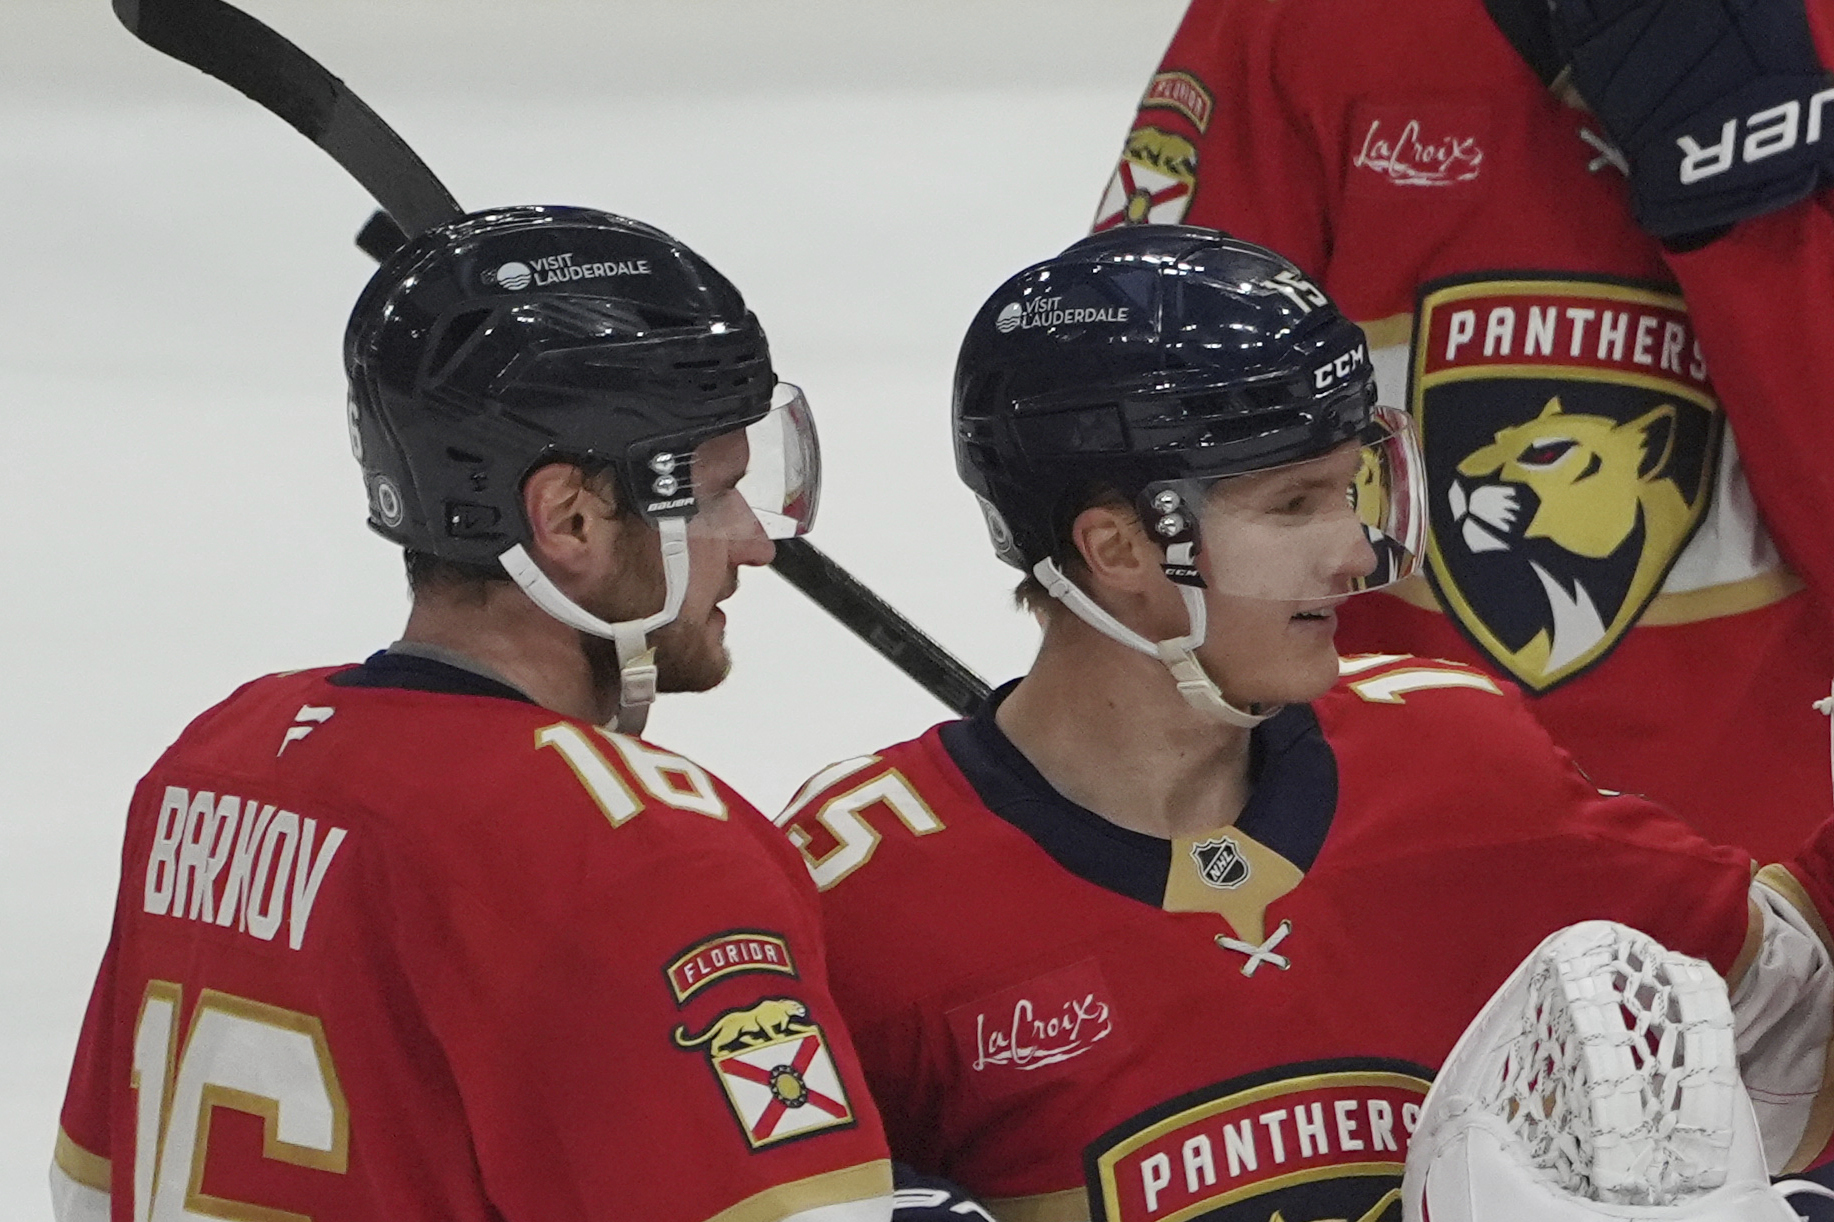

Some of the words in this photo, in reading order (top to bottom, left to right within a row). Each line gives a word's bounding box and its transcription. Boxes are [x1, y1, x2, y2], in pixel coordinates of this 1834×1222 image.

[529, 252, 573, 272] VISIT
[533, 260, 651, 286] LAUDERDALE
[1026, 296, 1062, 313] VISIT
[1022, 307, 1129, 329] LAUDERDALE
[1314, 344, 1363, 388] CCM
[1165, 568, 1199, 576] CCM
[534, 720, 728, 830] 16
[143, 785, 349, 951] BARKOV
[683, 942, 778, 984] FLORIDA
